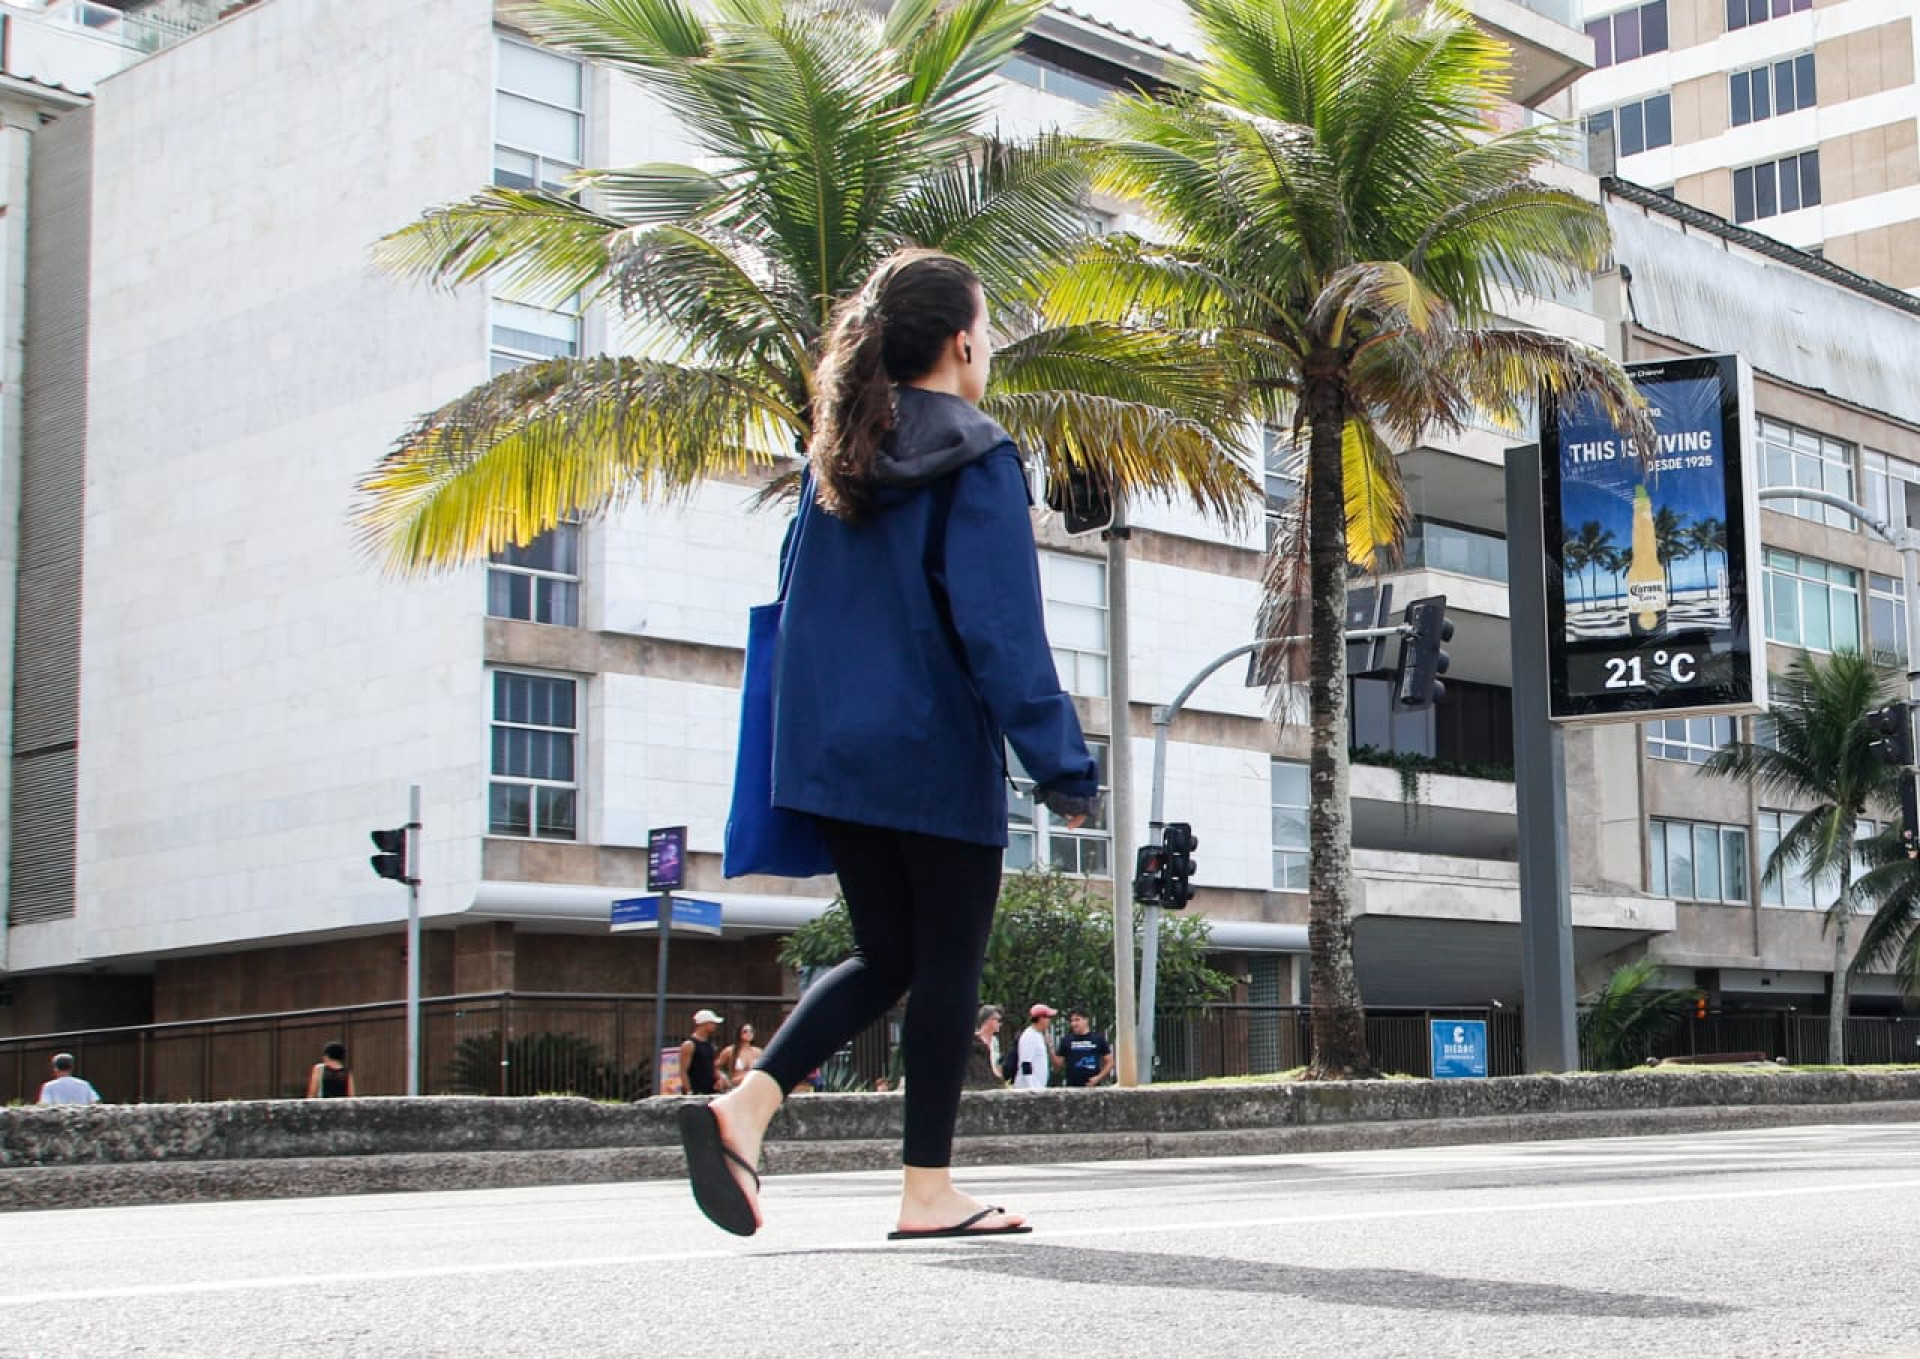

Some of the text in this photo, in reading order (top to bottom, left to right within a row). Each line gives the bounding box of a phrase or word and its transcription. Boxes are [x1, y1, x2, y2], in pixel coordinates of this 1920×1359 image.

[1568, 430, 1712, 463] THIS IS IVING
[1648, 455, 1714, 472] DESDE 1925
[1604, 656, 1647, 688] 21
